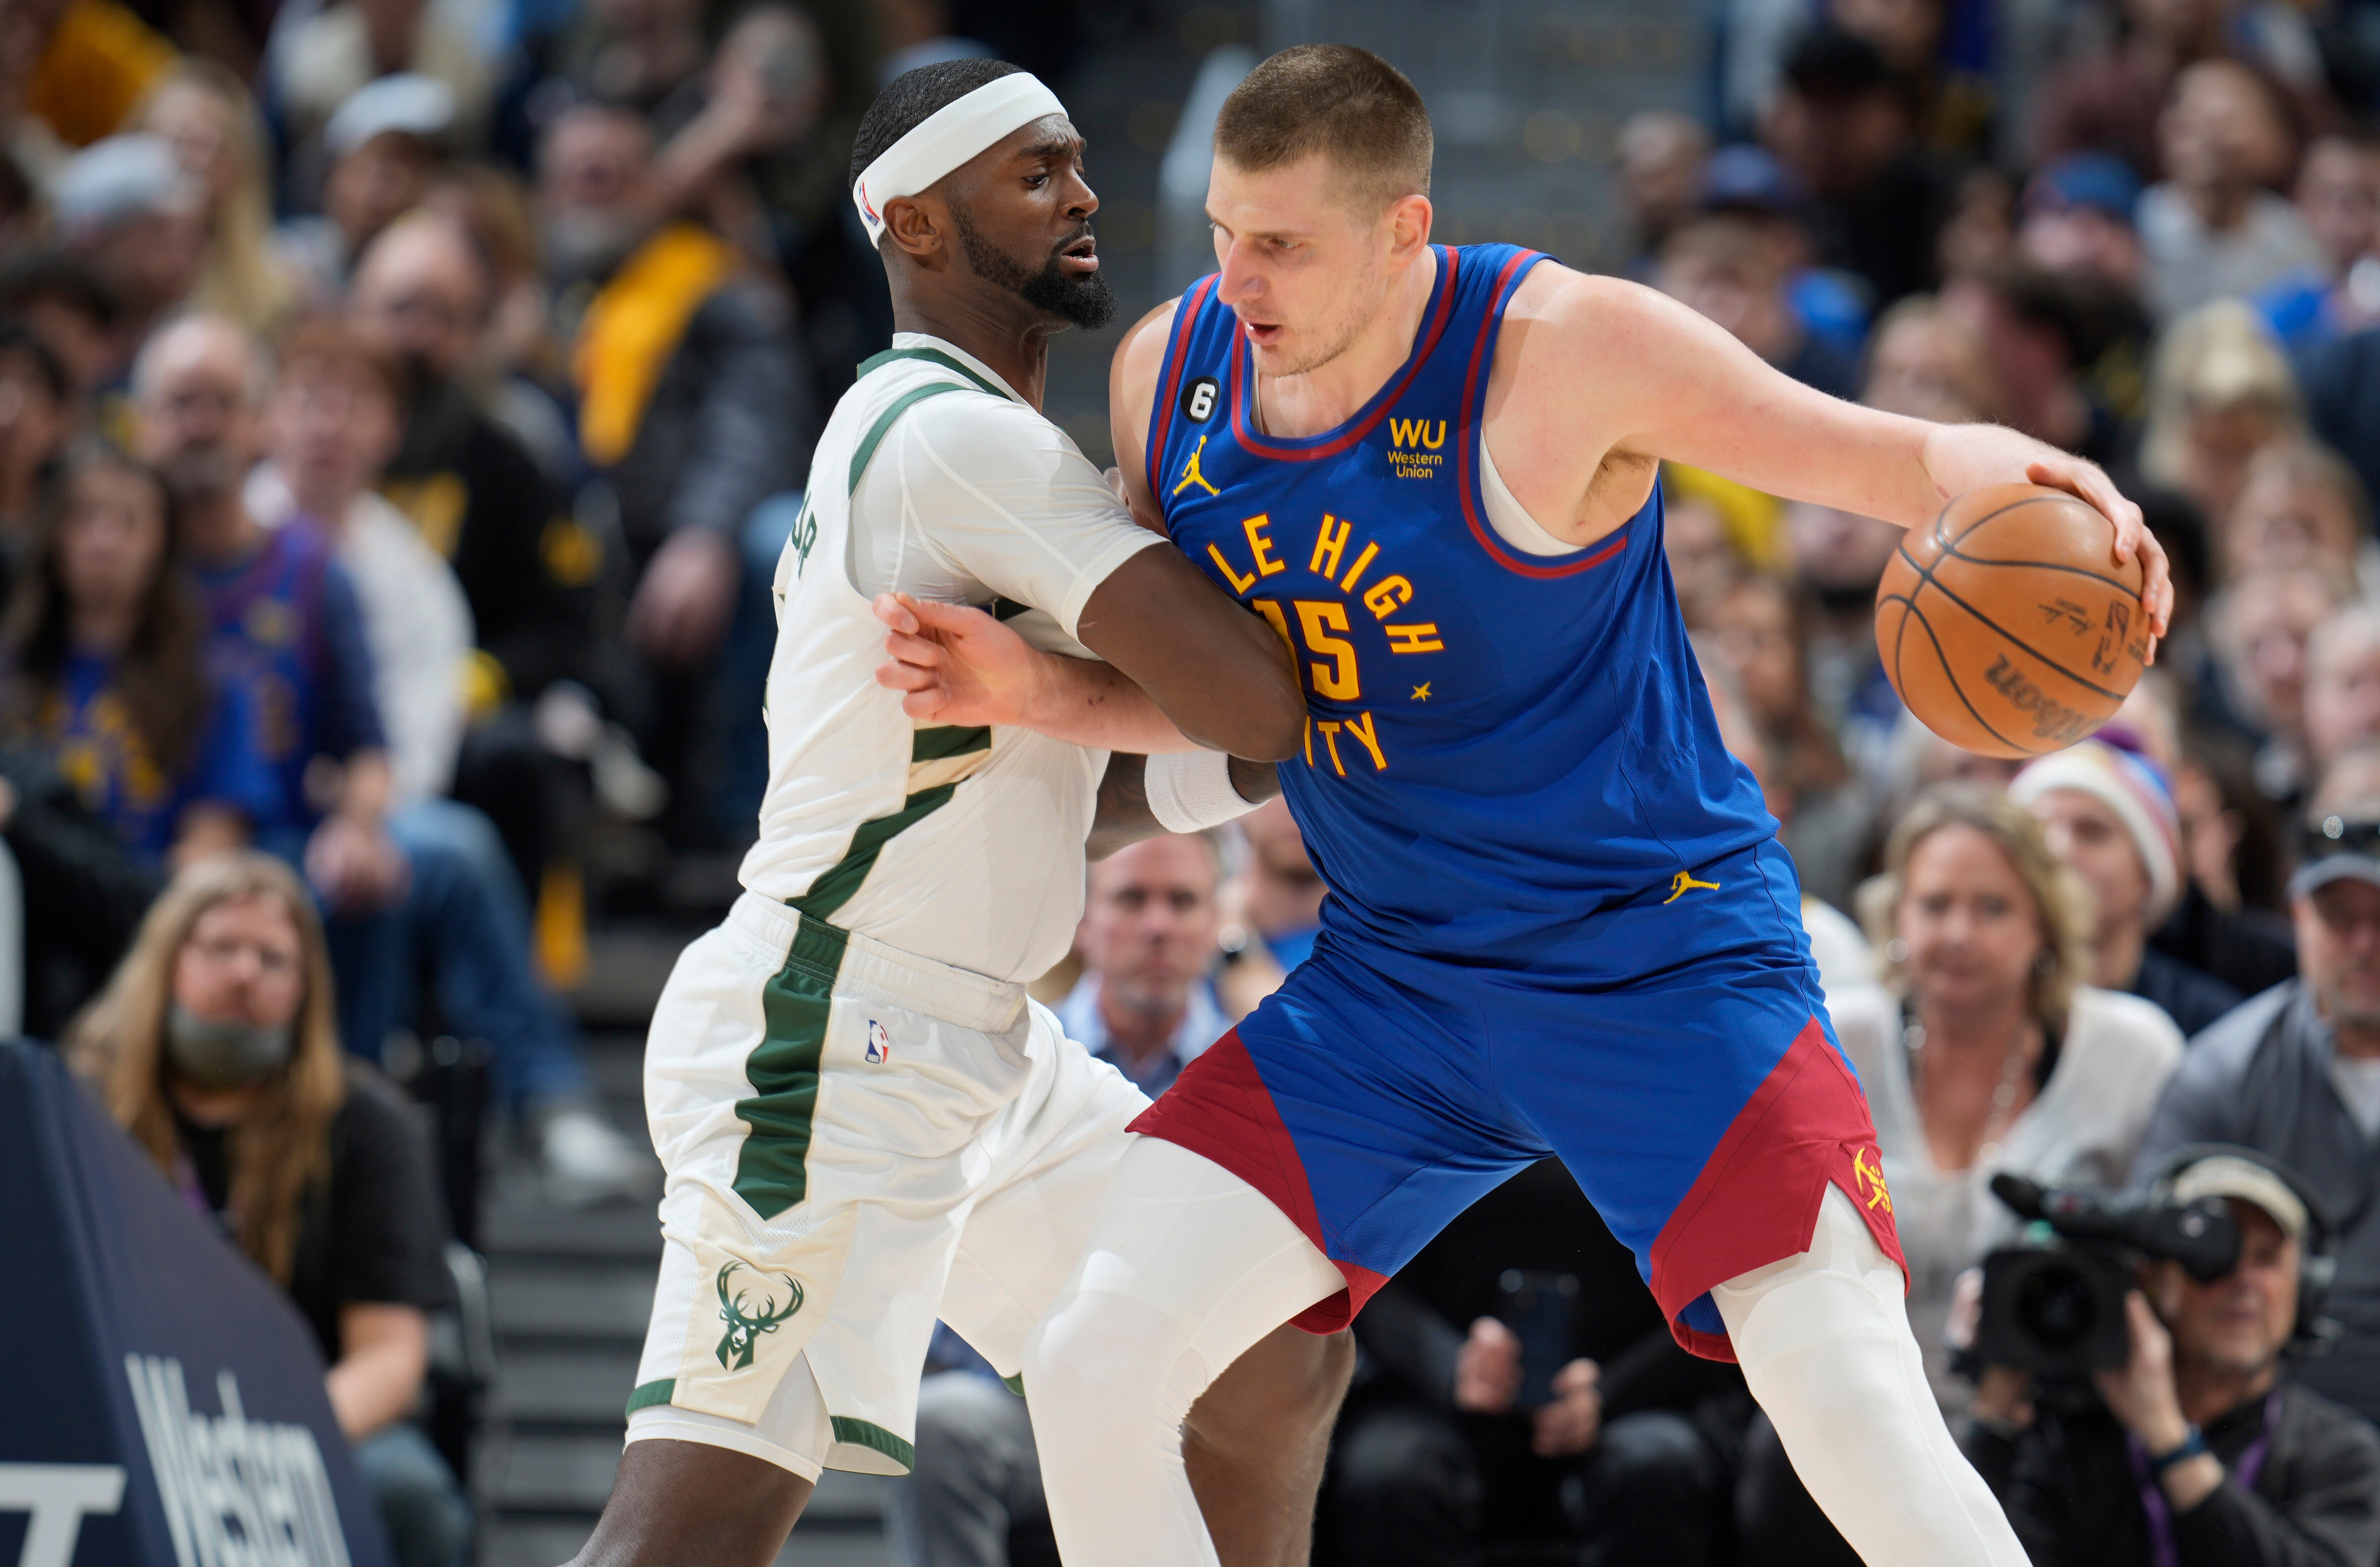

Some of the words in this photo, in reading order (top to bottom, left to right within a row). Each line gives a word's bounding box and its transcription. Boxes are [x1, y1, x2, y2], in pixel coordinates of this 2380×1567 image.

[1189, 382, 1216, 419] 6
[1389, 418, 1446, 449] WU
[1388, 450, 1443, 465] Western
[1396, 464, 1434, 478] Union
[1205, 512, 1286, 596] LE
[1308, 511, 1445, 654] HIGH
[1303, 710, 1389, 777] ITY
[868, 1053, 879, 1063] NBA
